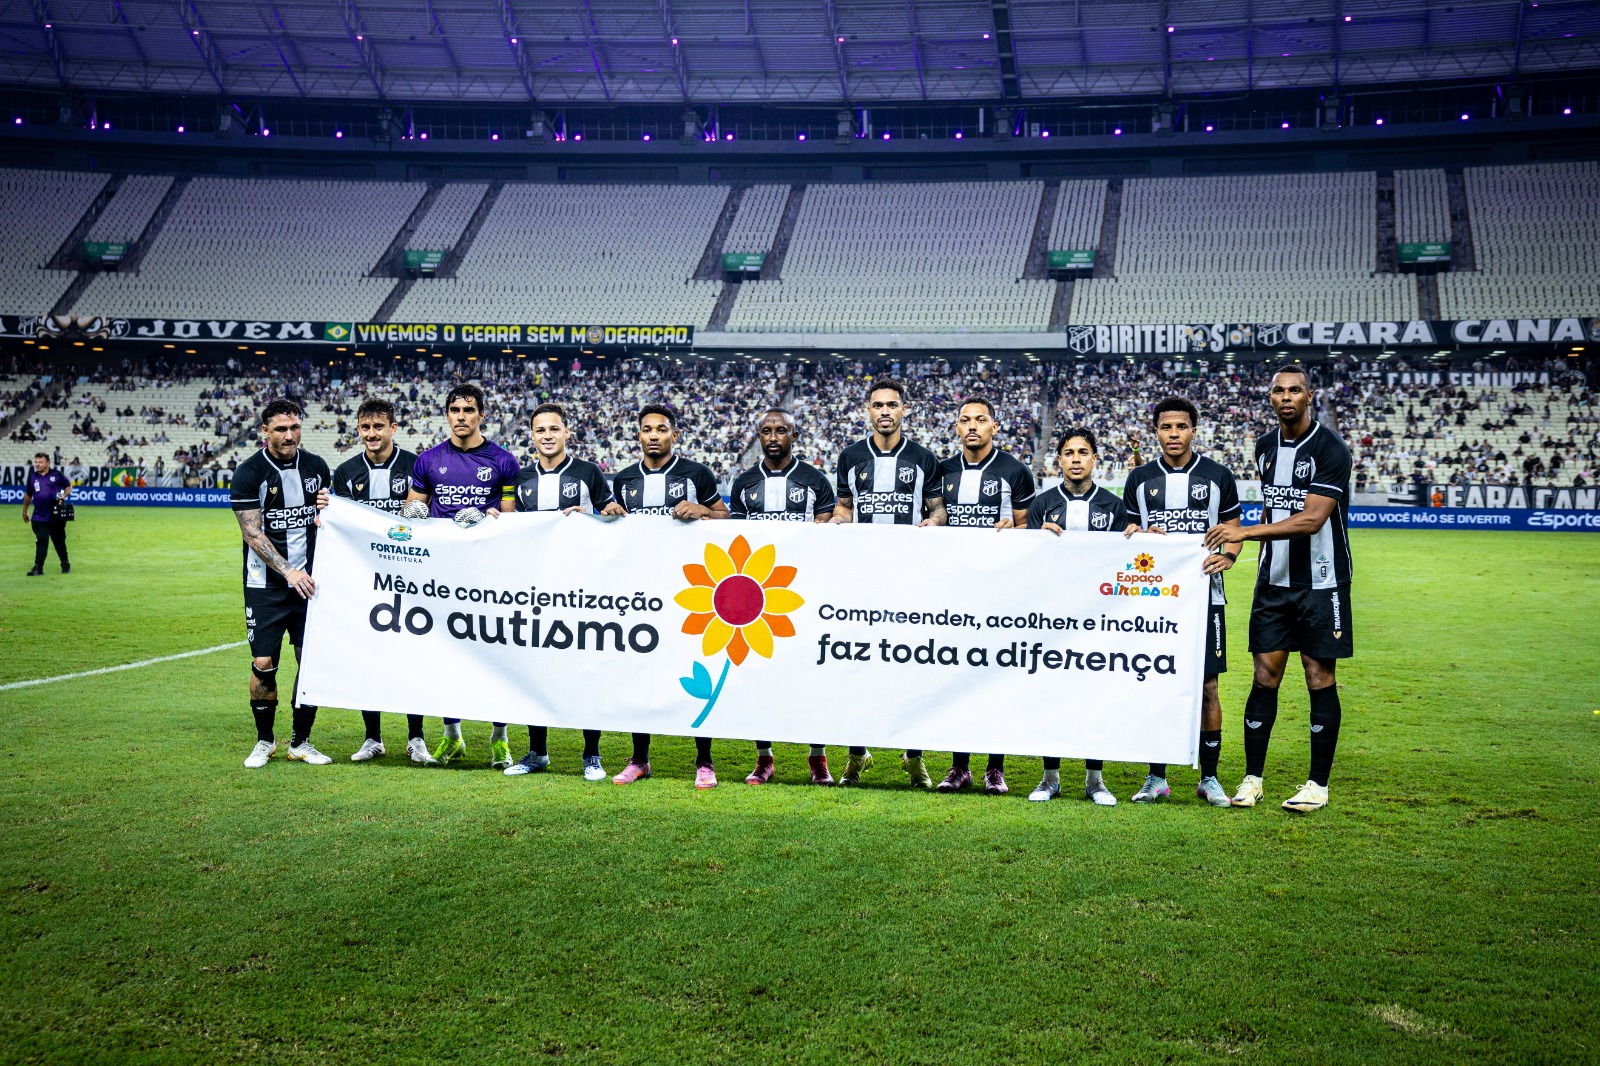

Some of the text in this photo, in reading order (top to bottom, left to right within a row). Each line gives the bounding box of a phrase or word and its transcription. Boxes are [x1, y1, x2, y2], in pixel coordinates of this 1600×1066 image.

[137, 319, 315, 340] JOVEM
[358, 324, 437, 342] VIVEMOS
[443, 325, 455, 342] O
[527, 326, 564, 343] SEM
[1455, 318, 1585, 342] CANA
[116, 492, 149, 501] DUVIDO
[150, 491, 174, 502] VOCÊ
[175, 492, 193, 502] NÃO
[195, 493, 207, 502] SE
[435, 484, 492, 496] Esportes
[857, 491, 913, 504] Esportes
[1147, 508, 1208, 522] Esportes
[1378, 511, 1411, 523] VOCÊ
[1412, 512, 1437, 523] NÃO
[1439, 514, 1455, 523] SE
[1457, 514, 1511, 525] DIVERTIR
[370, 542, 430, 557] FORTALEZA
[379, 553, 423, 564] PREFEITURA
[1116, 572, 1163, 585] Espaço
[373, 572, 664, 616] Mês de conscientização
[1099, 582, 1180, 598] Girassol
[369, 593, 660, 654] do autismo
[818, 603, 1179, 634] Compreender, acolher e incluir
[816, 633, 1177, 682] faz toda a diferença
